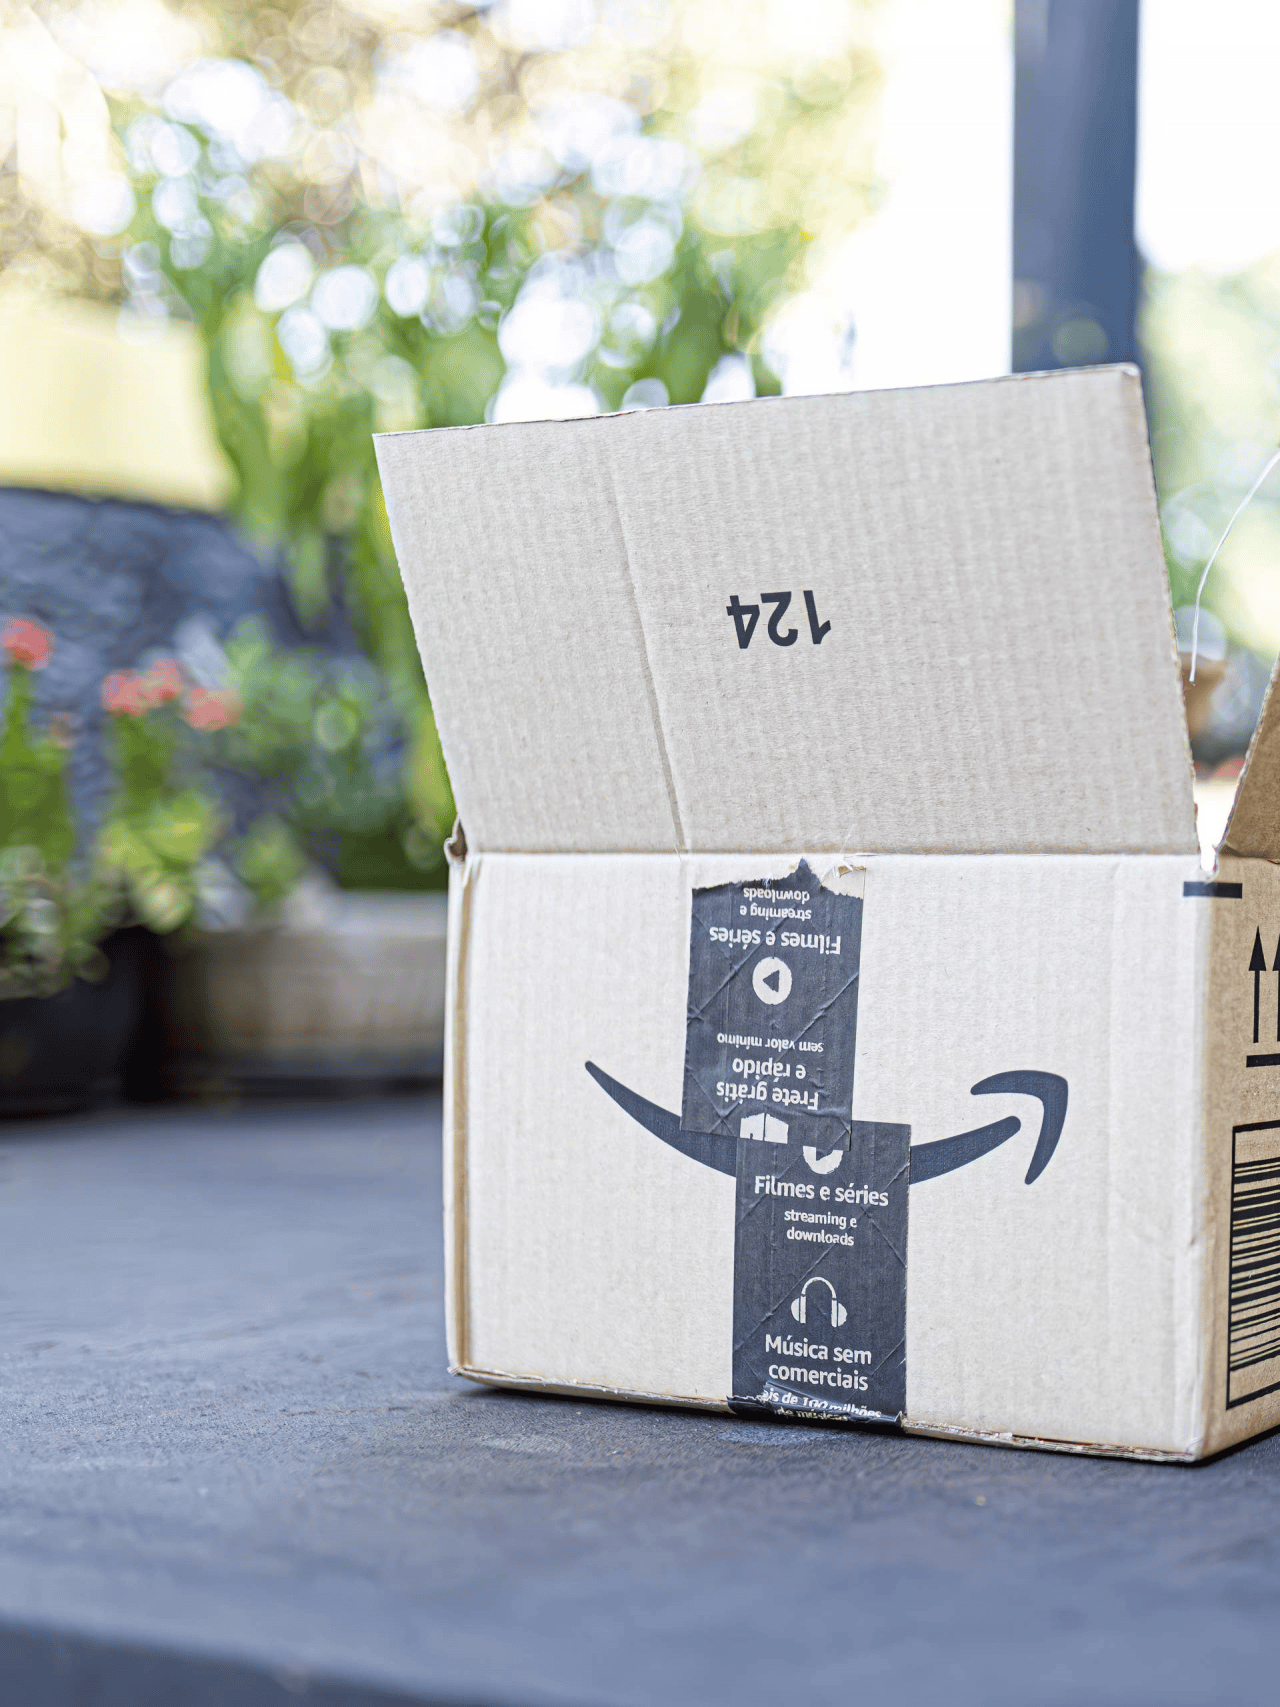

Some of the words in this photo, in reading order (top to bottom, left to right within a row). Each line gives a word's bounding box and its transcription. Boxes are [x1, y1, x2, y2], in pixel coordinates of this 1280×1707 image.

[726, 590, 831, 649] 124
[743, 887, 810, 903] downloads
[739, 904, 747, 916] e
[750, 904, 812, 921] streaming
[709, 926, 761, 949] séries
[765, 930, 776, 945] e
[781, 932, 841, 955] Filmes
[717, 1032, 763, 1047] mínimo
[765, 1037, 796, 1050] valor
[798, 1041, 824, 1052] sem
[732, 1058, 791, 1083] rápido
[795, 1064, 807, 1080] e
[716, 1081, 767, 1104] grátis
[772, 1088, 819, 1110] Frete
[754, 1175, 815, 1200] Filmes
[819, 1186, 831, 1202] e
[835, 1182, 889, 1207] séries
[784, 1209, 847, 1230] streaming
[850, 1216, 857, 1228] e
[786, 1226, 855, 1247] downloads
[765, 1334, 829, 1361] Música
[833, 1346, 872, 1365] sem
[768, 1364, 869, 1391] comerciais
[781, 1392, 798, 1405] de
